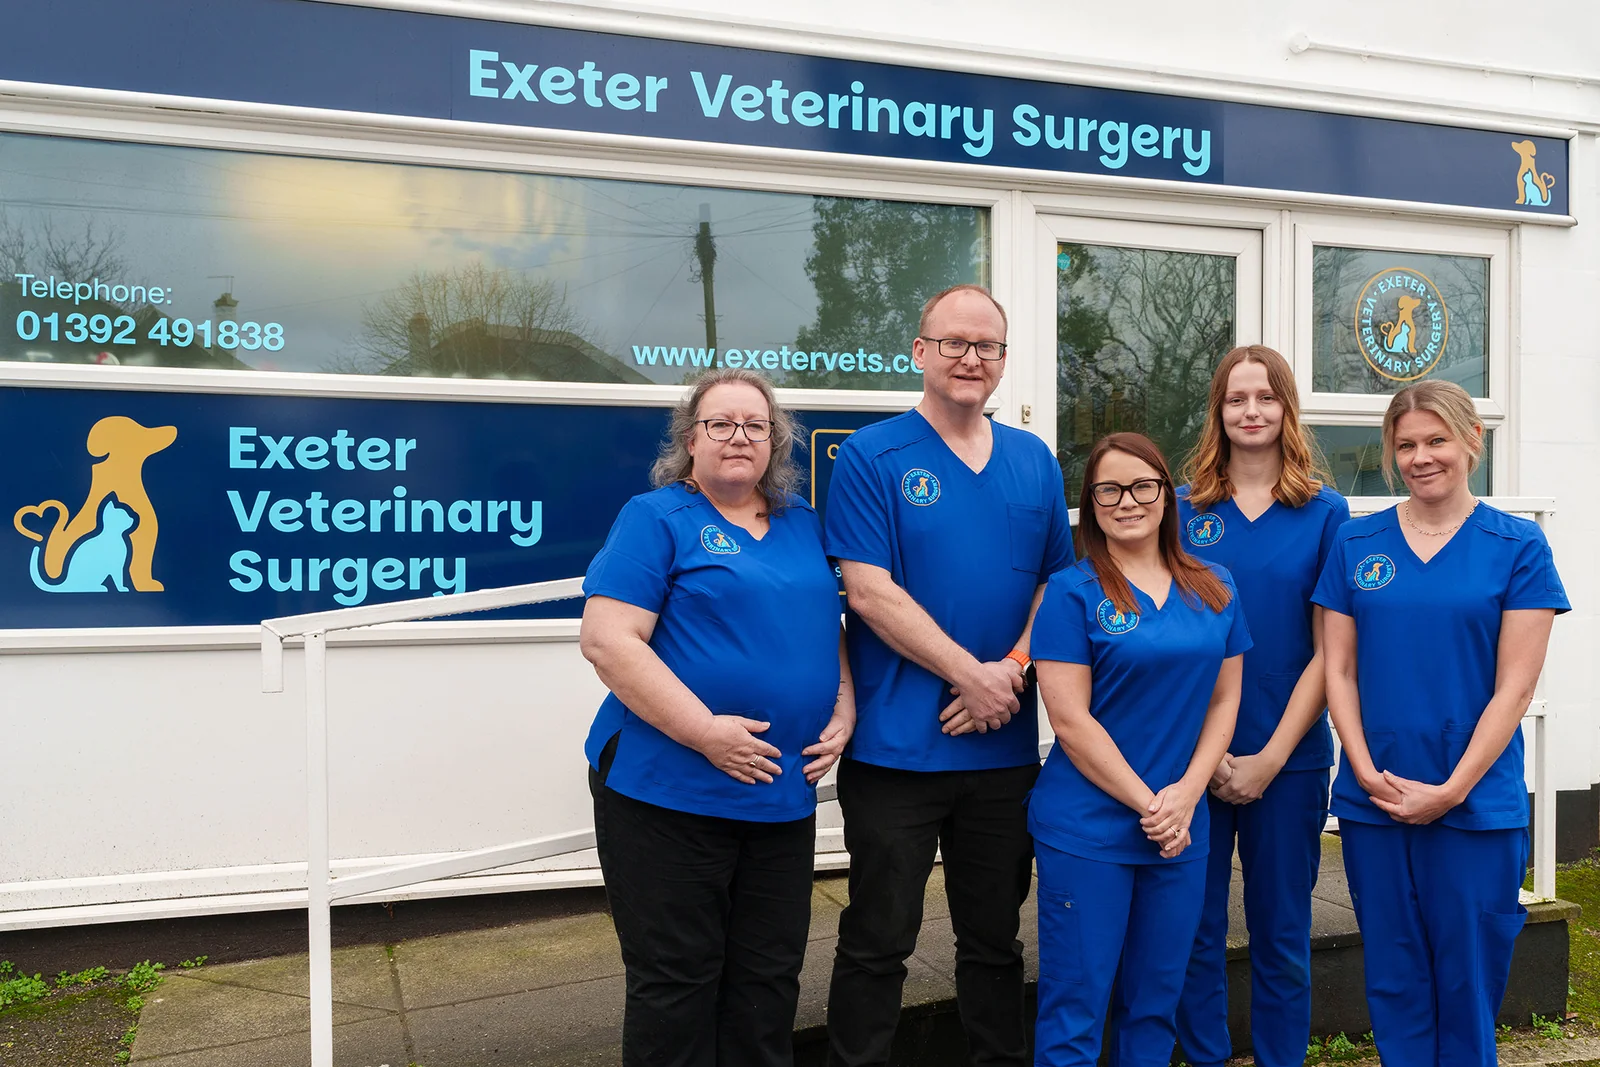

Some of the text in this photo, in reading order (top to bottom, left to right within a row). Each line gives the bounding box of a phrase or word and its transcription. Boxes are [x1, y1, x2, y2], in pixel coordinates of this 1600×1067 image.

[469, 49, 1211, 176] Exeter Veterinary Surgery
[15, 273, 173, 306] Telephone:
[1377, 275, 1426, 297] EXETER
[16, 310, 286, 352] 01392 491838
[1361, 297, 1442, 373] VETERINARY SURGERY
[229, 426, 417, 471] Exeter
[226, 485, 543, 547] Veterinary
[228, 549, 466, 605] Surgery
